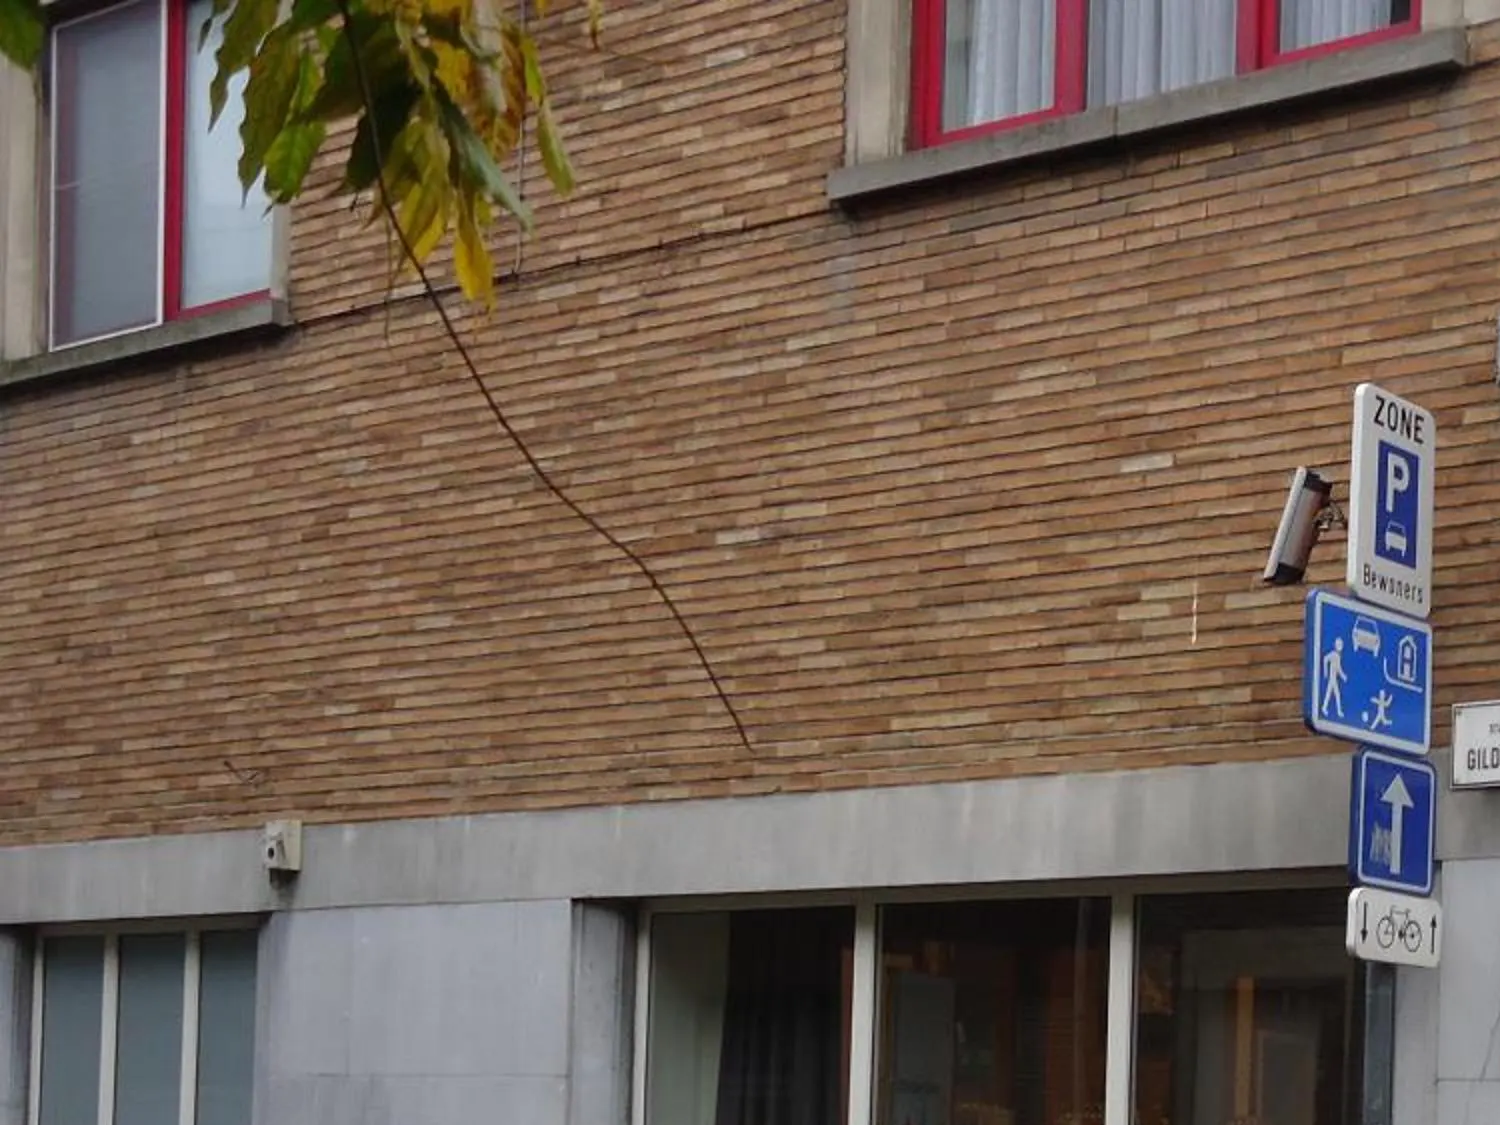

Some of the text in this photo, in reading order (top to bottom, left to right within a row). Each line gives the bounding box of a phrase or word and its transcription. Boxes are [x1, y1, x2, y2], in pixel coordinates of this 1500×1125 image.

[1373, 395, 1425, 444] ZONE
[1385, 451, 1410, 513] P
[1362, 563, 1424, 605] Bewoners
